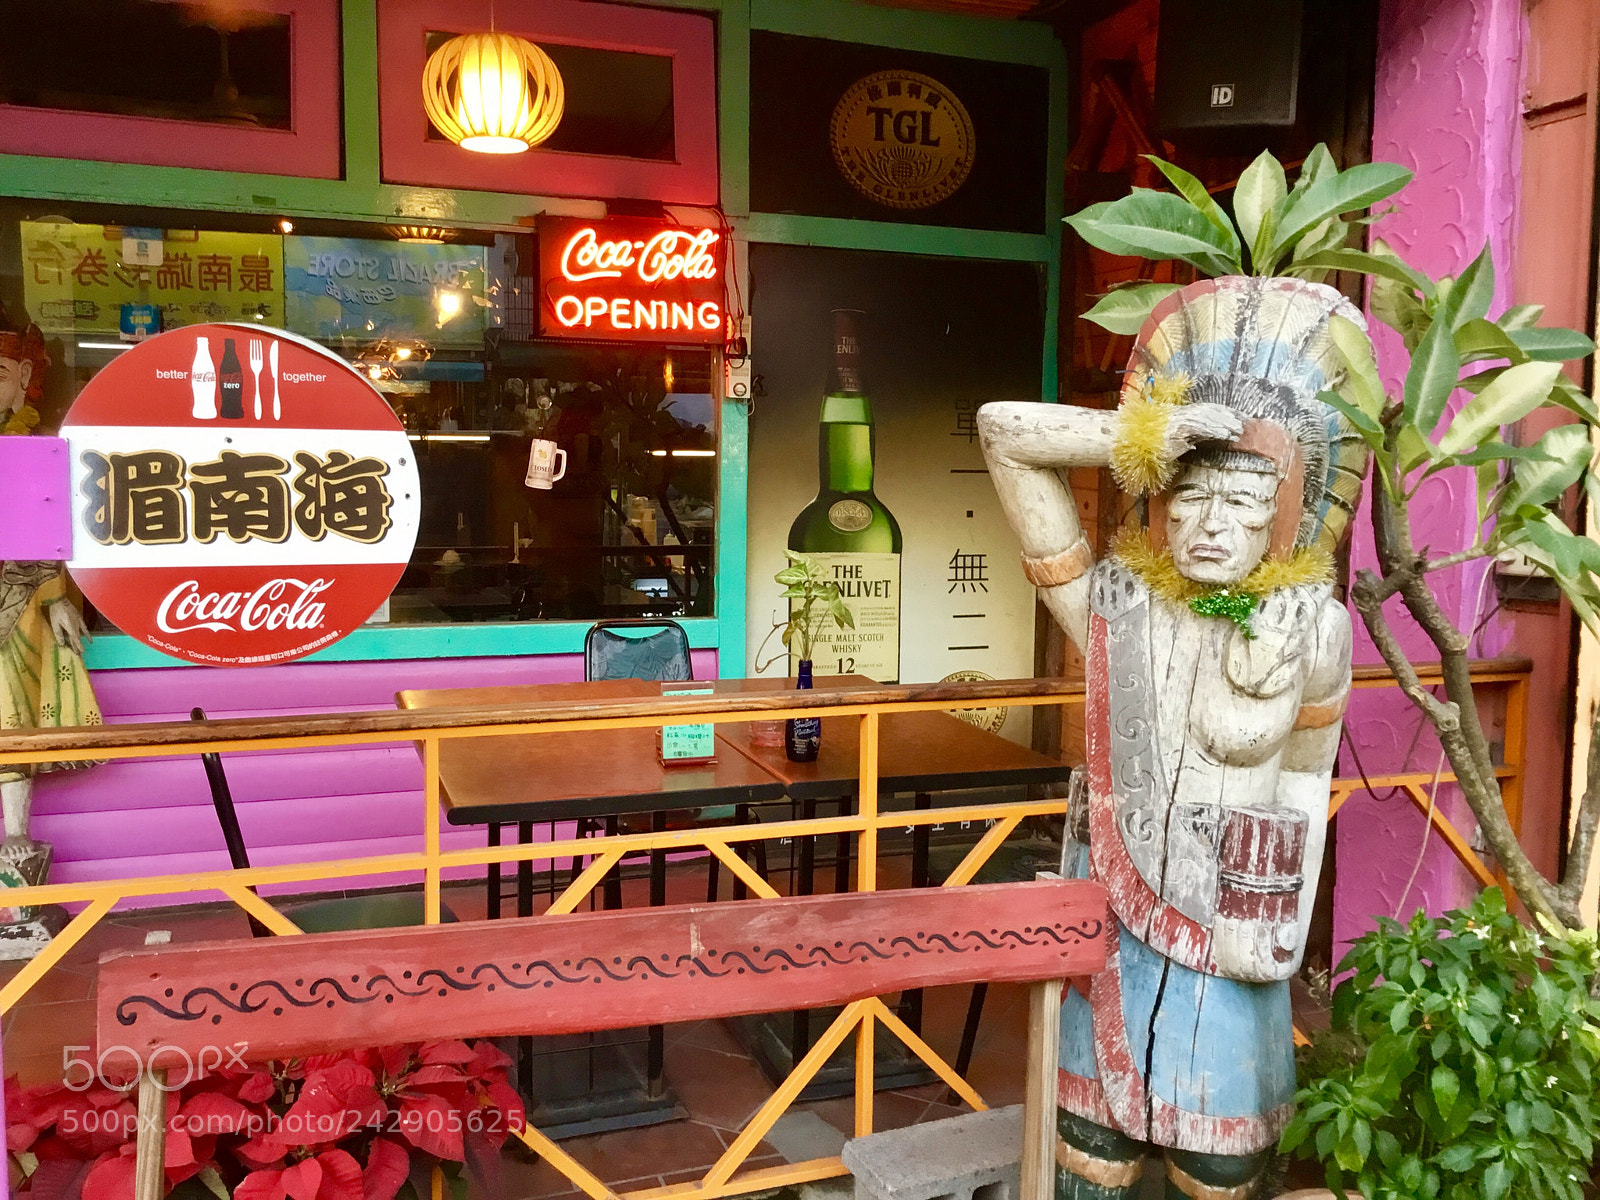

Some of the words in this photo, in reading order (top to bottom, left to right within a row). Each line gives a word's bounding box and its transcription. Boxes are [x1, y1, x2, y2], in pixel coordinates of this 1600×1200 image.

[1212, 87, 1232, 105] ID
[866, 105, 941, 147] TGL
[560, 228, 720, 282] Coca-Cola
[556, 295, 720, 330] OPENING
[156, 369, 188, 380] better
[283, 372, 327, 384] together
[223, 381, 240, 390] zero
[530, 464, 553, 473] CLOSED
[832, 565, 863, 579] THE
[156, 578, 336, 633] Coca-Cola
[809, 634, 832, 643] SINGLE
[836, 633, 855, 642] MALT
[859, 632, 884, 642] SCOTCH
[831, 644, 861, 653] WHISKY
[836, 657, 856, 674] 12
